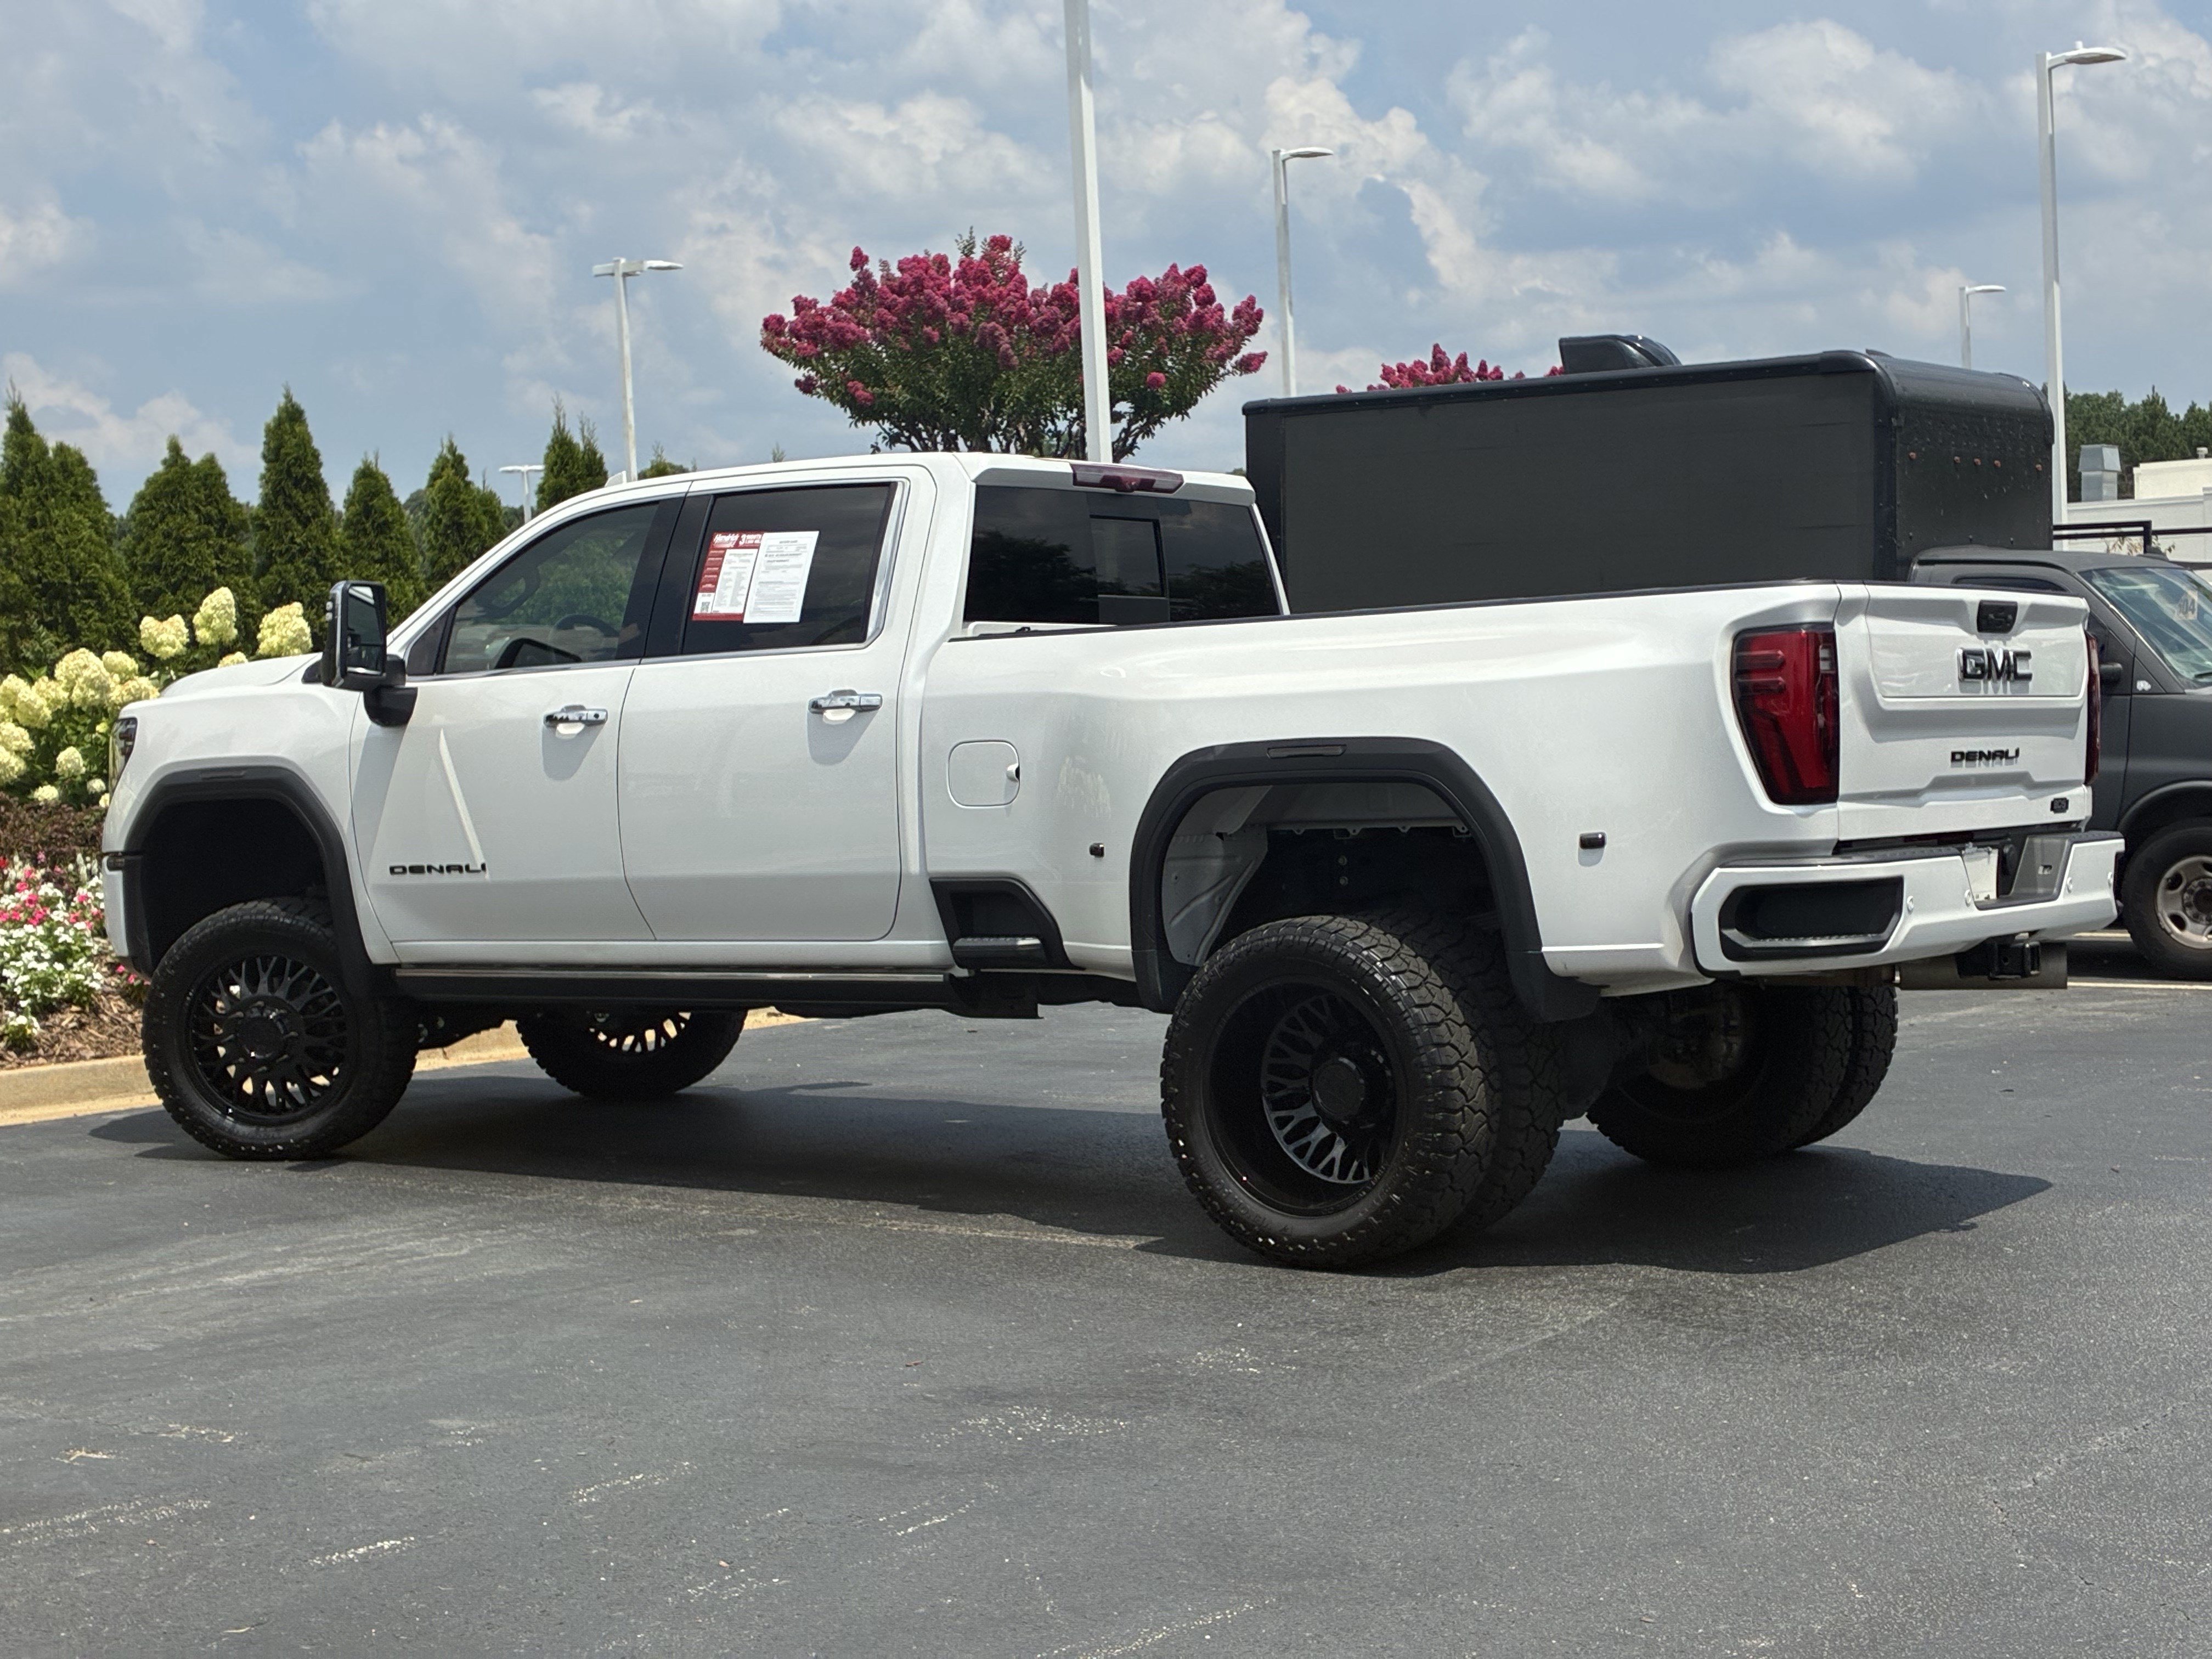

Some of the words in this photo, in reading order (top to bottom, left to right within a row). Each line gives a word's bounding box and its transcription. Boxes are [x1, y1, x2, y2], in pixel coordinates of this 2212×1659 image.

[1957, 648, 2033, 681] GMC
[1951, 747, 2019, 763] DENALI
[389, 862, 486, 876] DENALI
